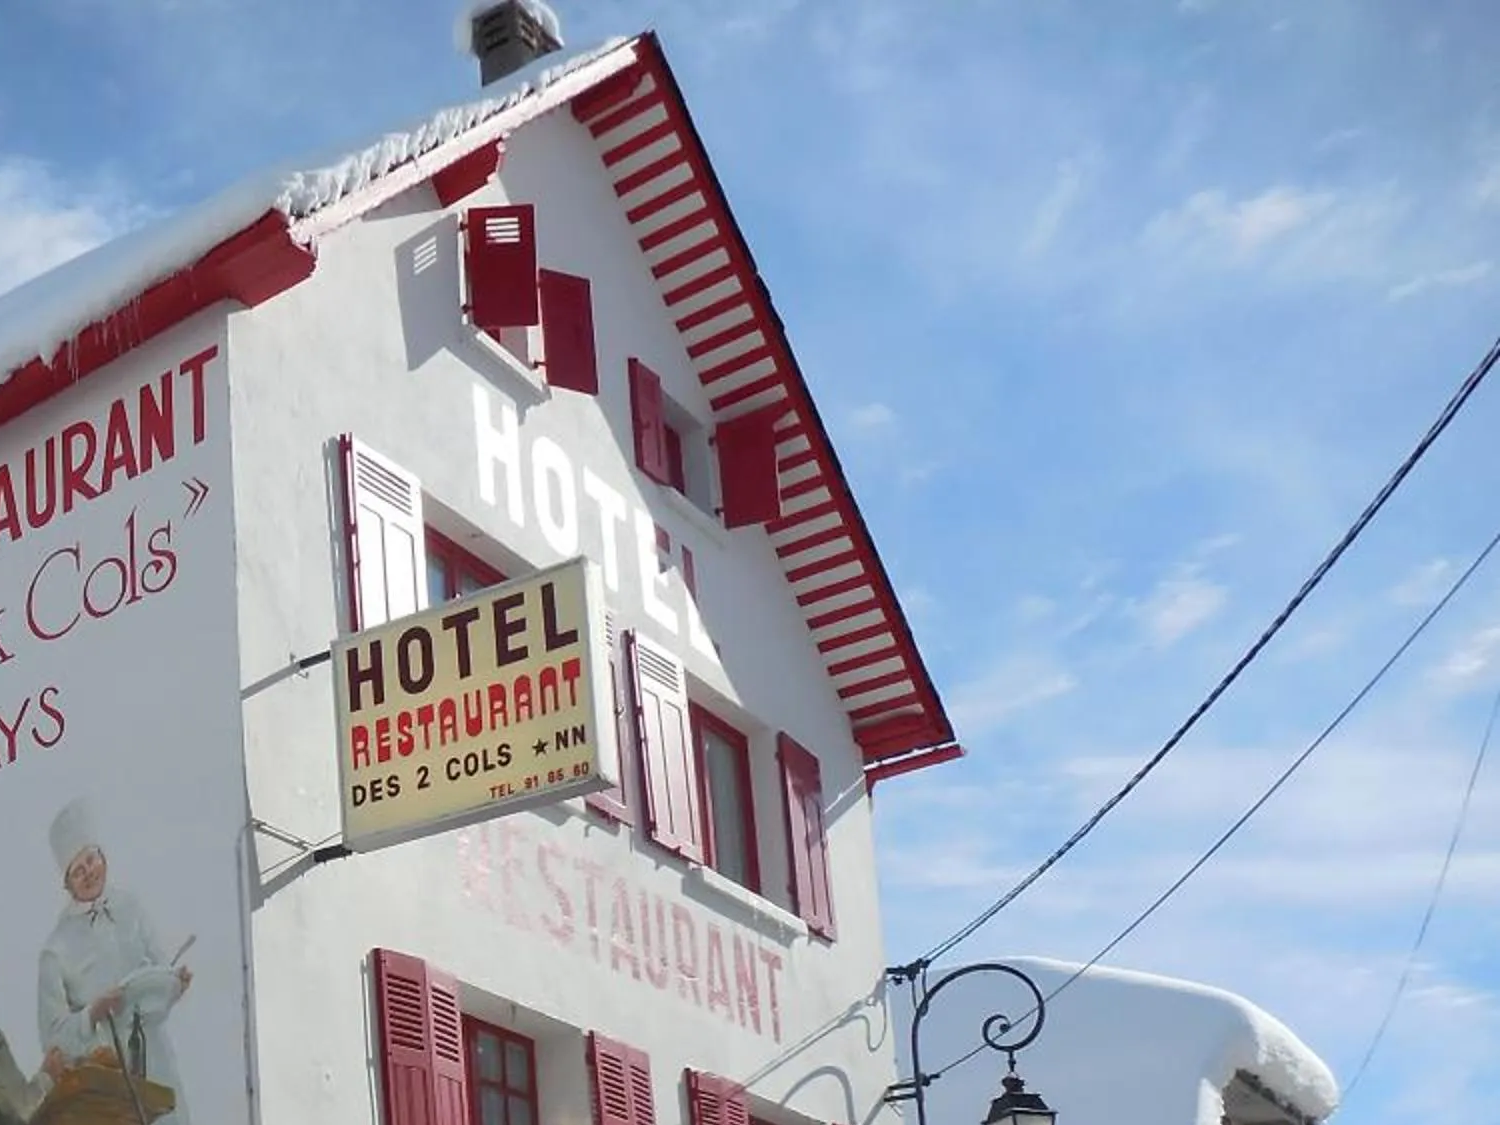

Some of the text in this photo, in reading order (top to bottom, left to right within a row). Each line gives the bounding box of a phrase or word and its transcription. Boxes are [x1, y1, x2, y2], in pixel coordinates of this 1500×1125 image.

[347, 582, 579, 713] HOTEL
[351, 657, 581, 771] RESTAURANT
[352, 774, 401, 808] DES
[416, 764, 431, 791] 2
[445, 742, 513, 782] COLS
[489, 783, 515, 799] TEL
